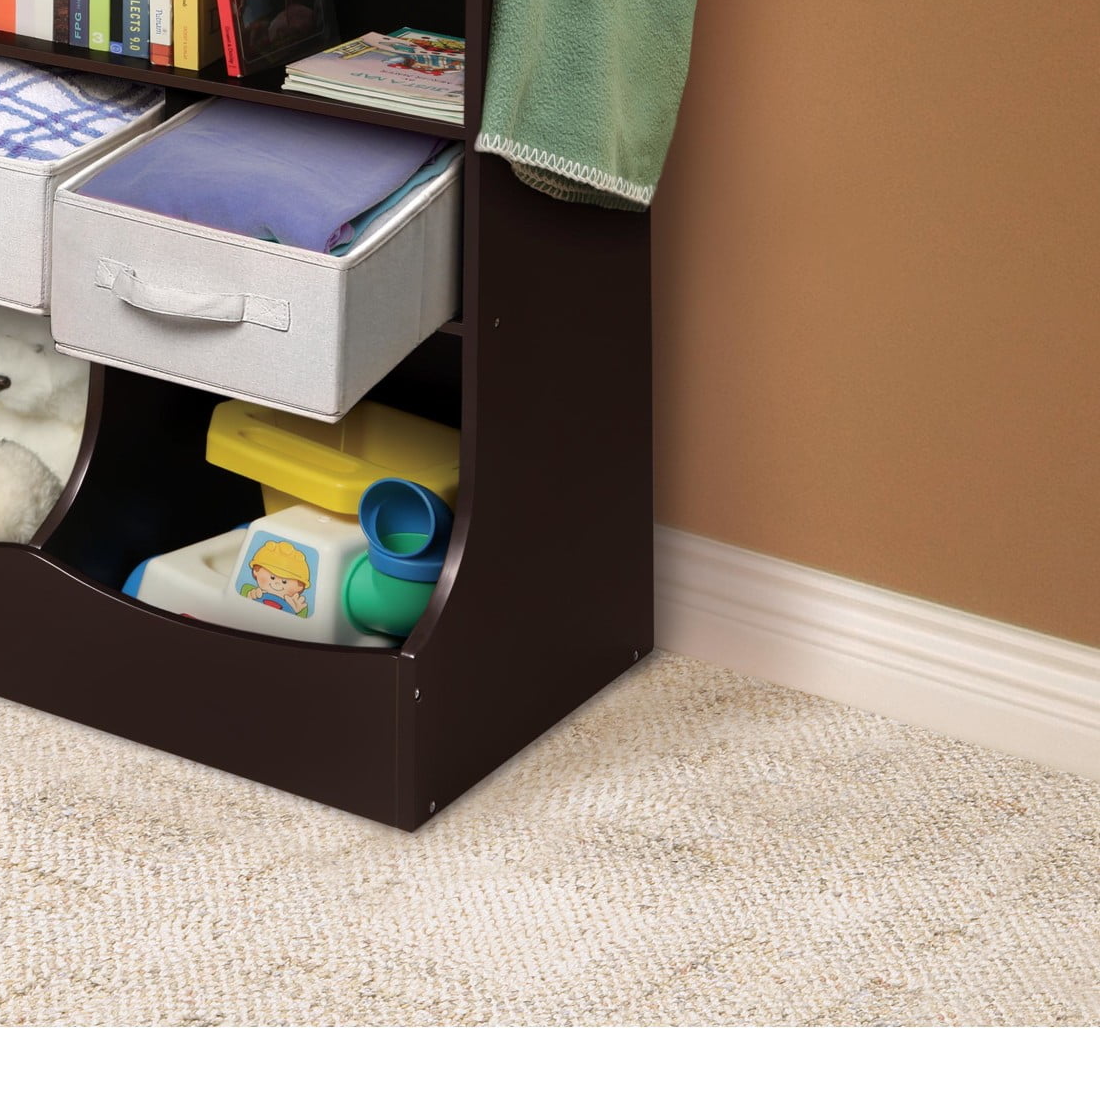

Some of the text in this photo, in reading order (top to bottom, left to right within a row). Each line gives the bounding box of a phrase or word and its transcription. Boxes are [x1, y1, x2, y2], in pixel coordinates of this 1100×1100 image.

[74, 12, 82, 39] FPG
[155, 9, 163, 35] Putnam
[129, 37, 141, 51] 9.0
